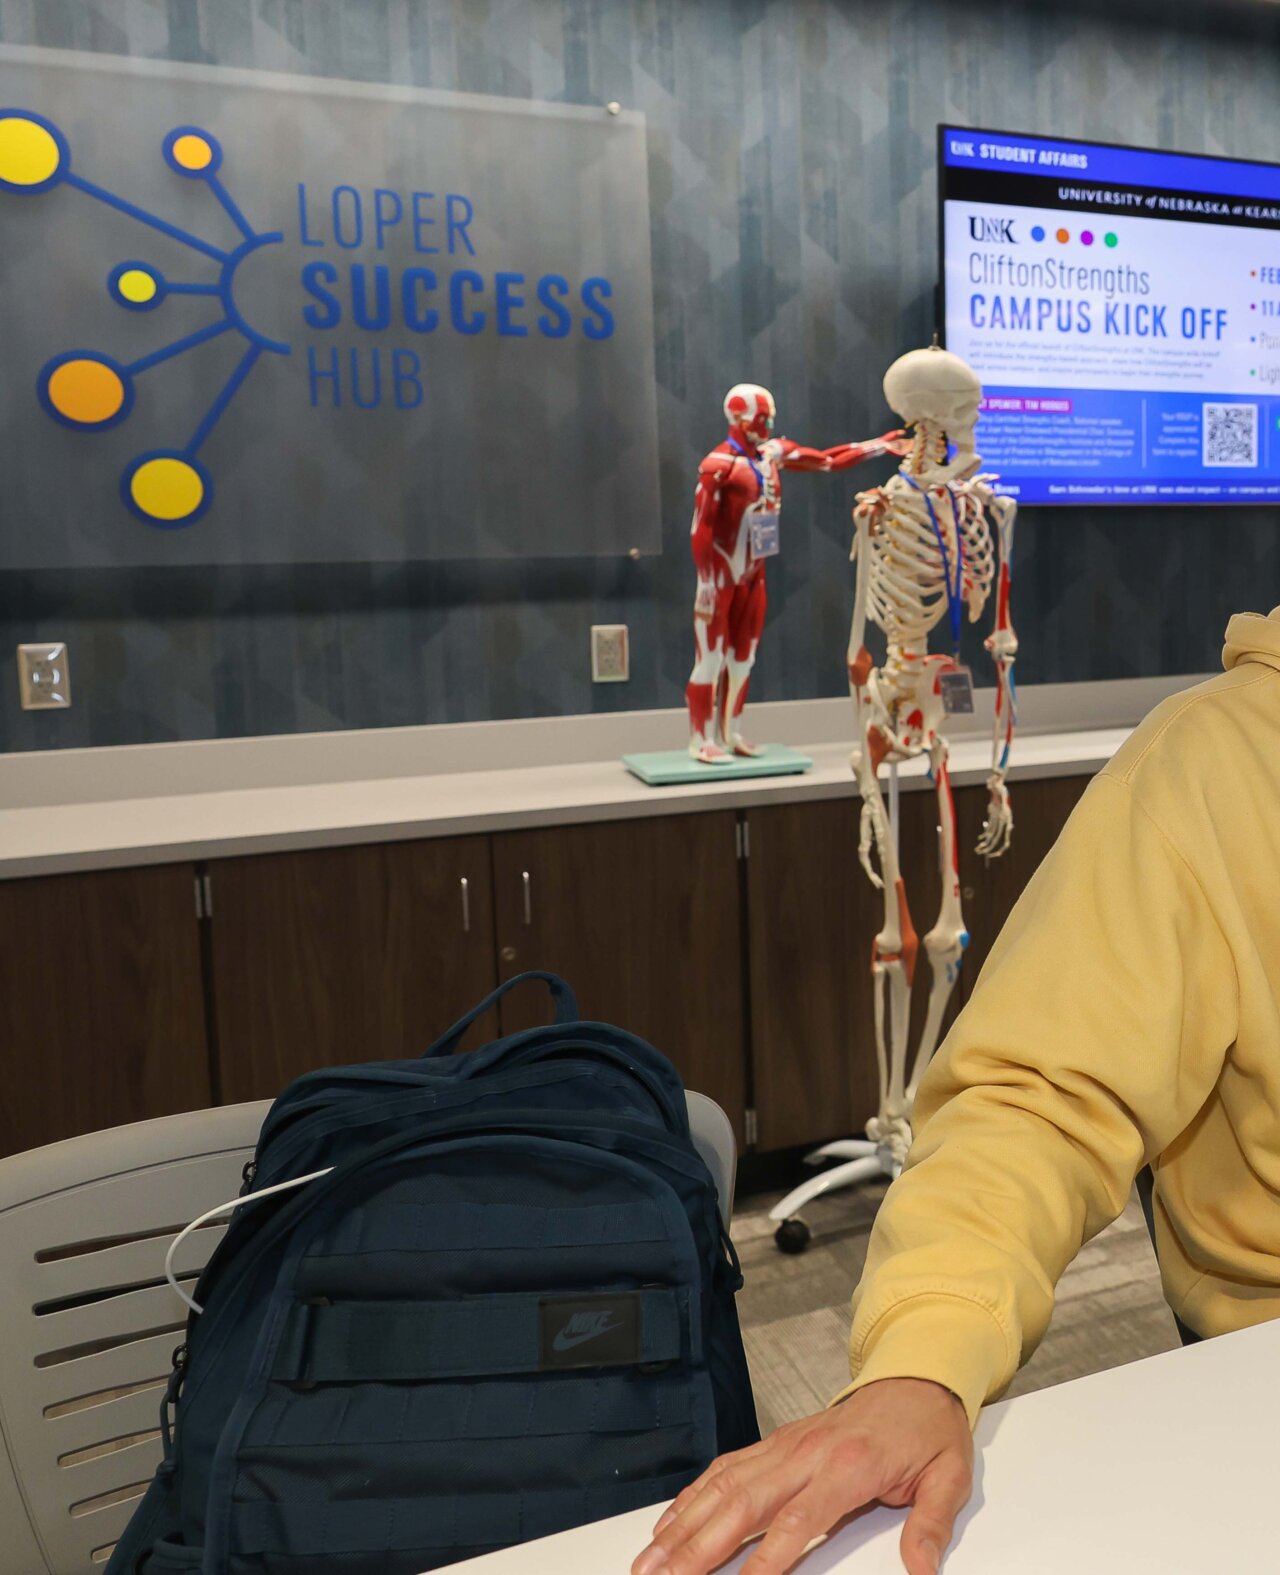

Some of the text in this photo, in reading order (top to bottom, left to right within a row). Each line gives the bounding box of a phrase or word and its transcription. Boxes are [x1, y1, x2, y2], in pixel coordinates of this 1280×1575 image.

[979, 143, 1037, 164] STUDENT
[1038, 150, 1088, 169] AFFAIRS
[297, 182, 477, 257] LOPER
[1058, 187, 1144, 207] UNIVERSITY
[1158, 197, 1230, 216] NEBRASKA
[969, 216, 1018, 244] UNK
[968, 251, 1151, 299] CliftonStrengths
[301, 260, 616, 341] SUCCESS
[969, 293, 1228, 341] CAMPUS KICK OFF
[306, 346, 425, 411] HUB
[563, 1310, 614, 1334] NIKE
